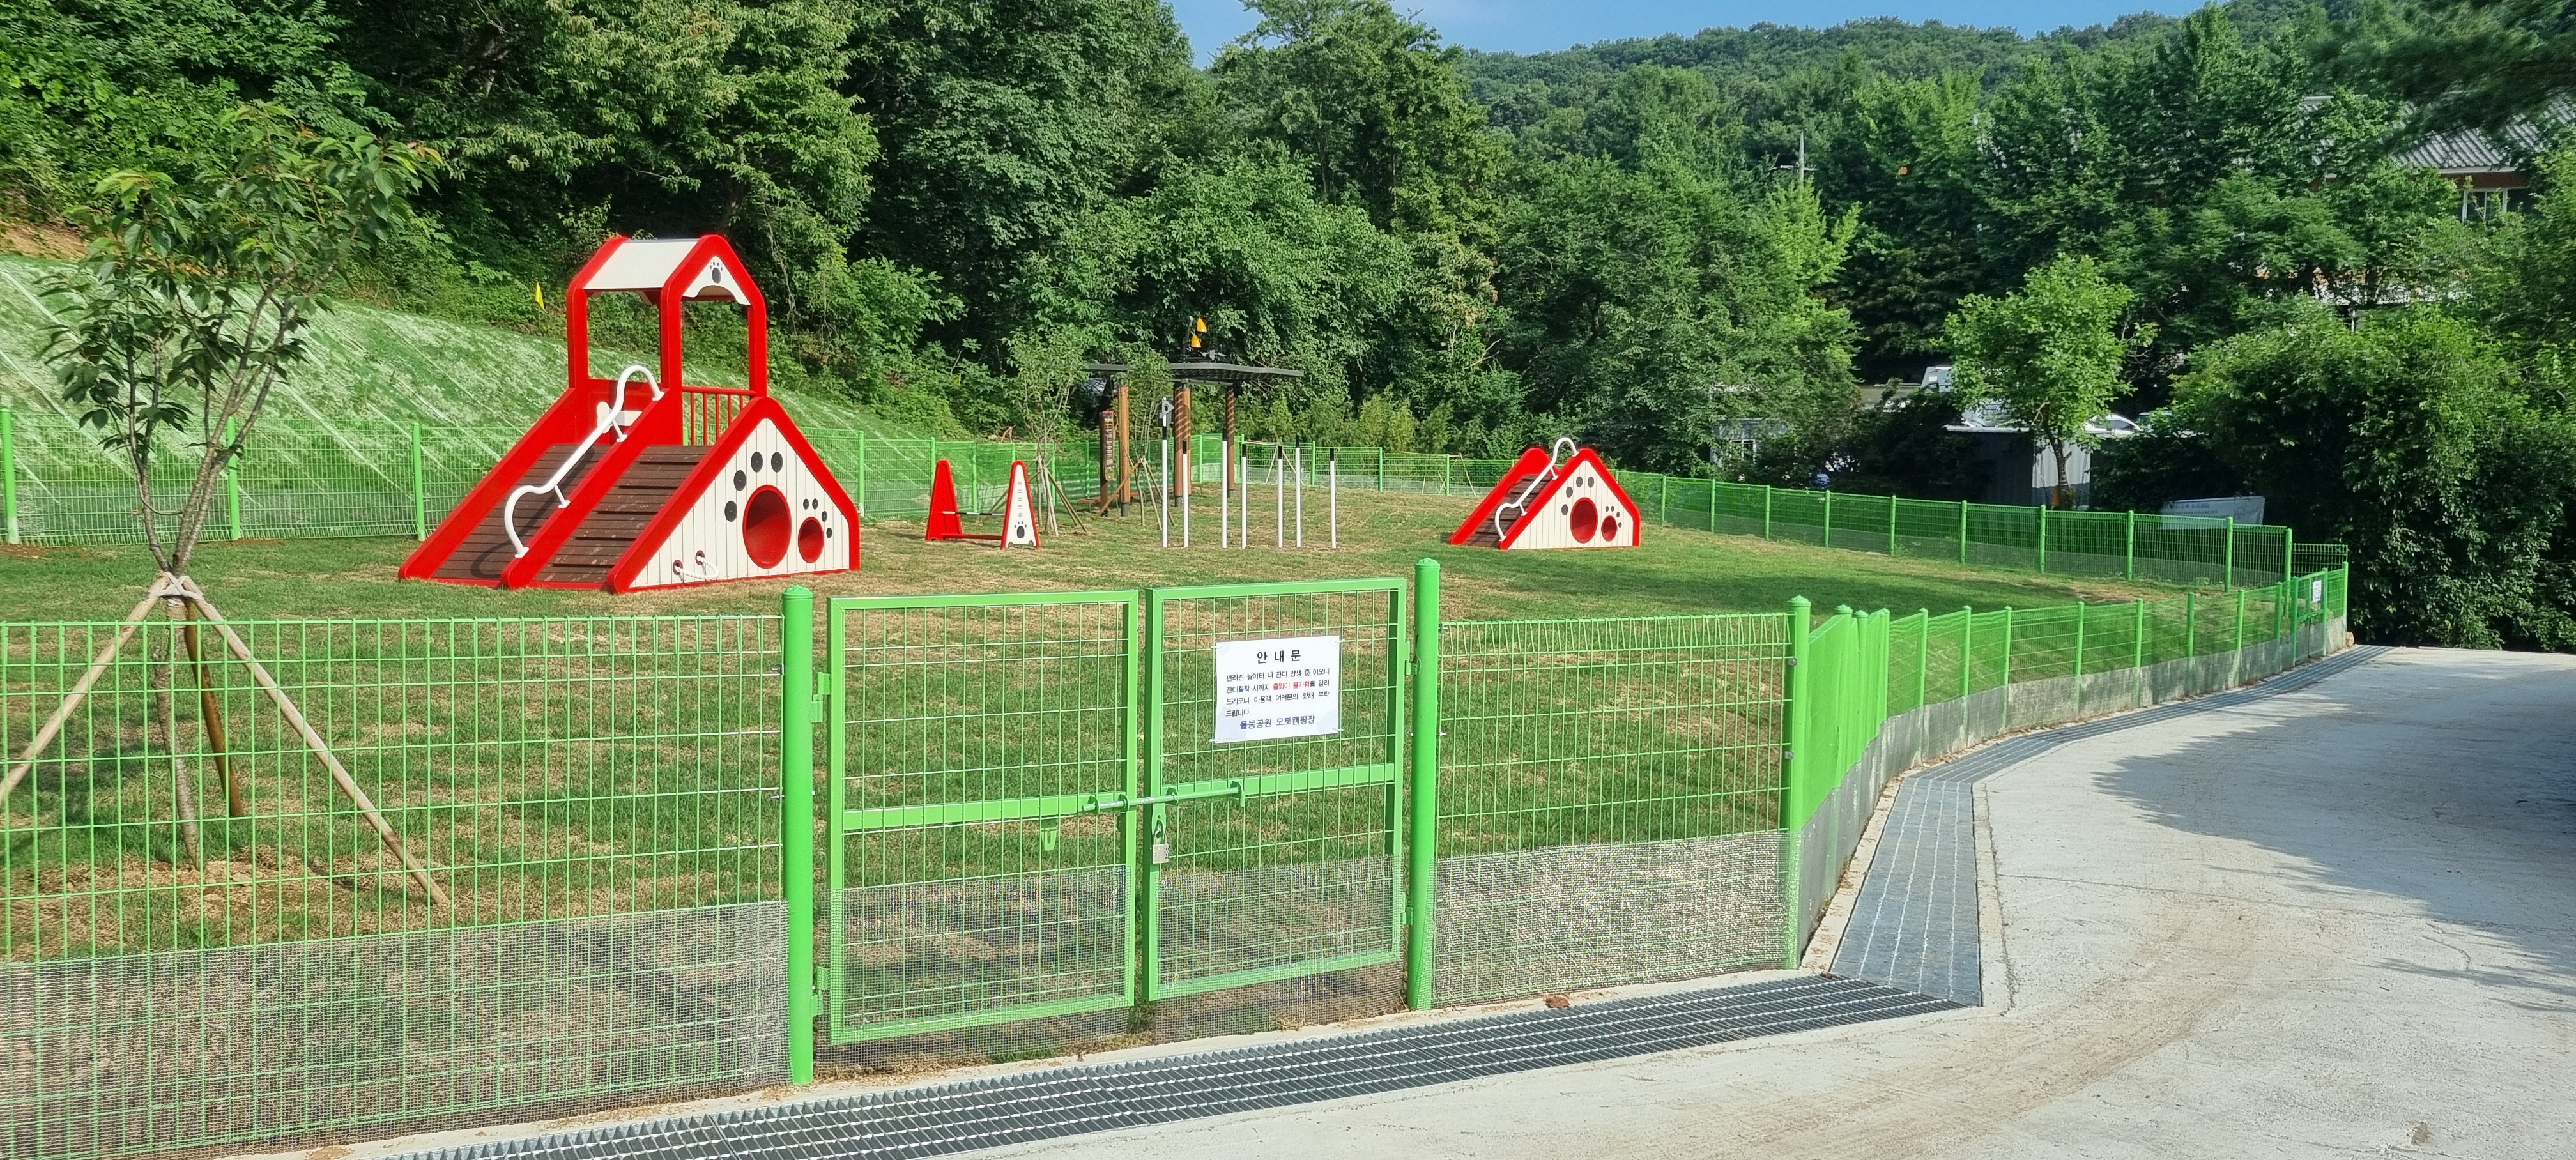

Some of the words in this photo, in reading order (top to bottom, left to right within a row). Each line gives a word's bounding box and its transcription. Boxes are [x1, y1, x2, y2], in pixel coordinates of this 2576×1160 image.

[1257, 651, 1268, 664] 안
[1275, 650, 1284, 662] 내
[1291, 650, 1301, 662] 문
[1247, 672, 1264, 680] 놀이터
[1293, 680, 1316, 689] 불가함을
[1225, 708, 1252, 717] 드립니다.
[1276, 715, 1315, 726] 오토캠핑장
